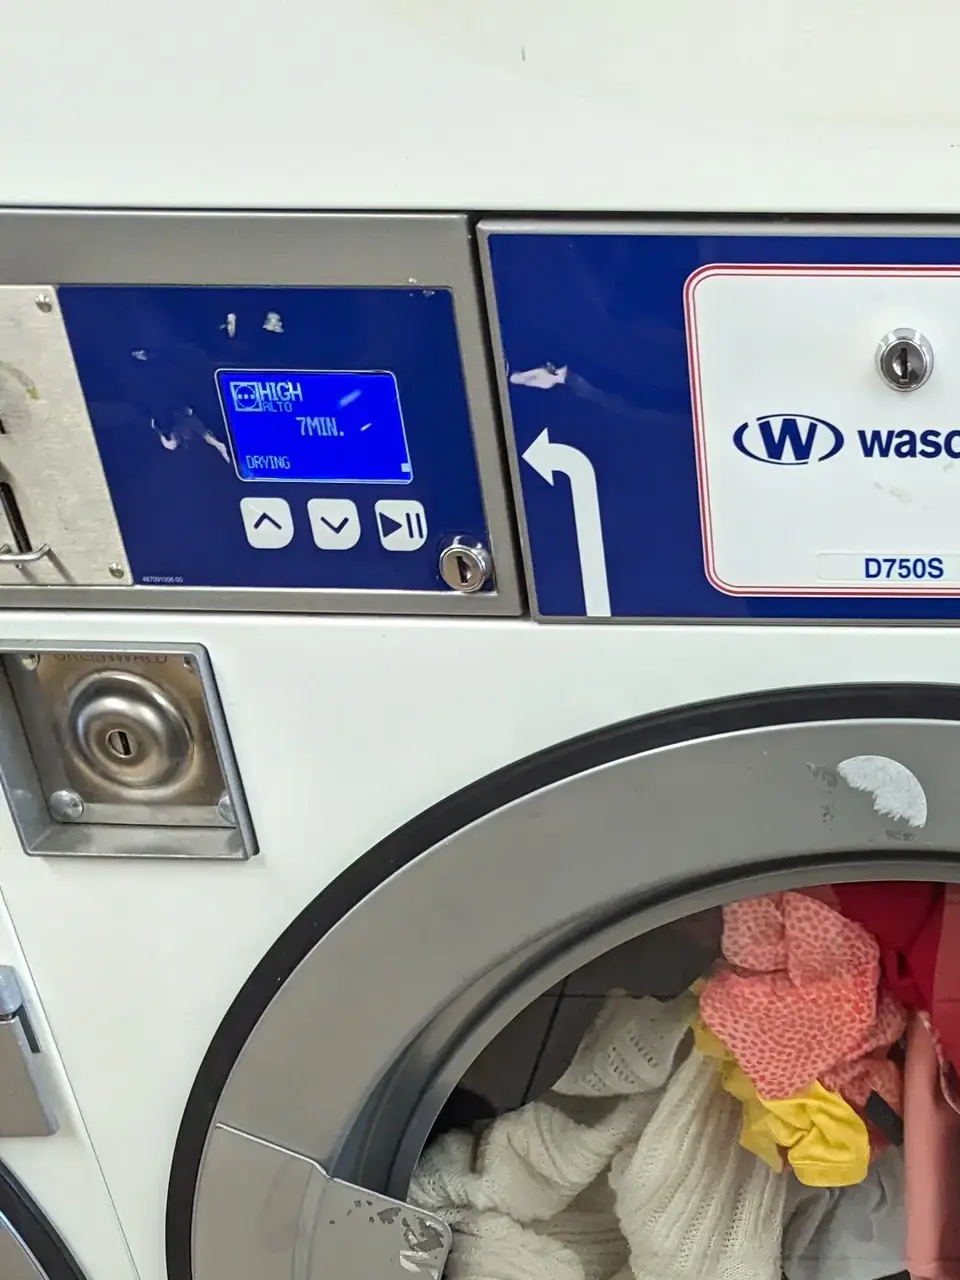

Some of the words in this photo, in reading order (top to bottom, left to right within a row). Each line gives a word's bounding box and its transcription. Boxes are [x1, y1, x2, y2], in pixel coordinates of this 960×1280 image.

[258, 381, 304, 402] HIGH
[262, 401, 292, 412] ALTO
[245, 455, 291, 469] DRYING
[864, 557, 945, 580] D750S
